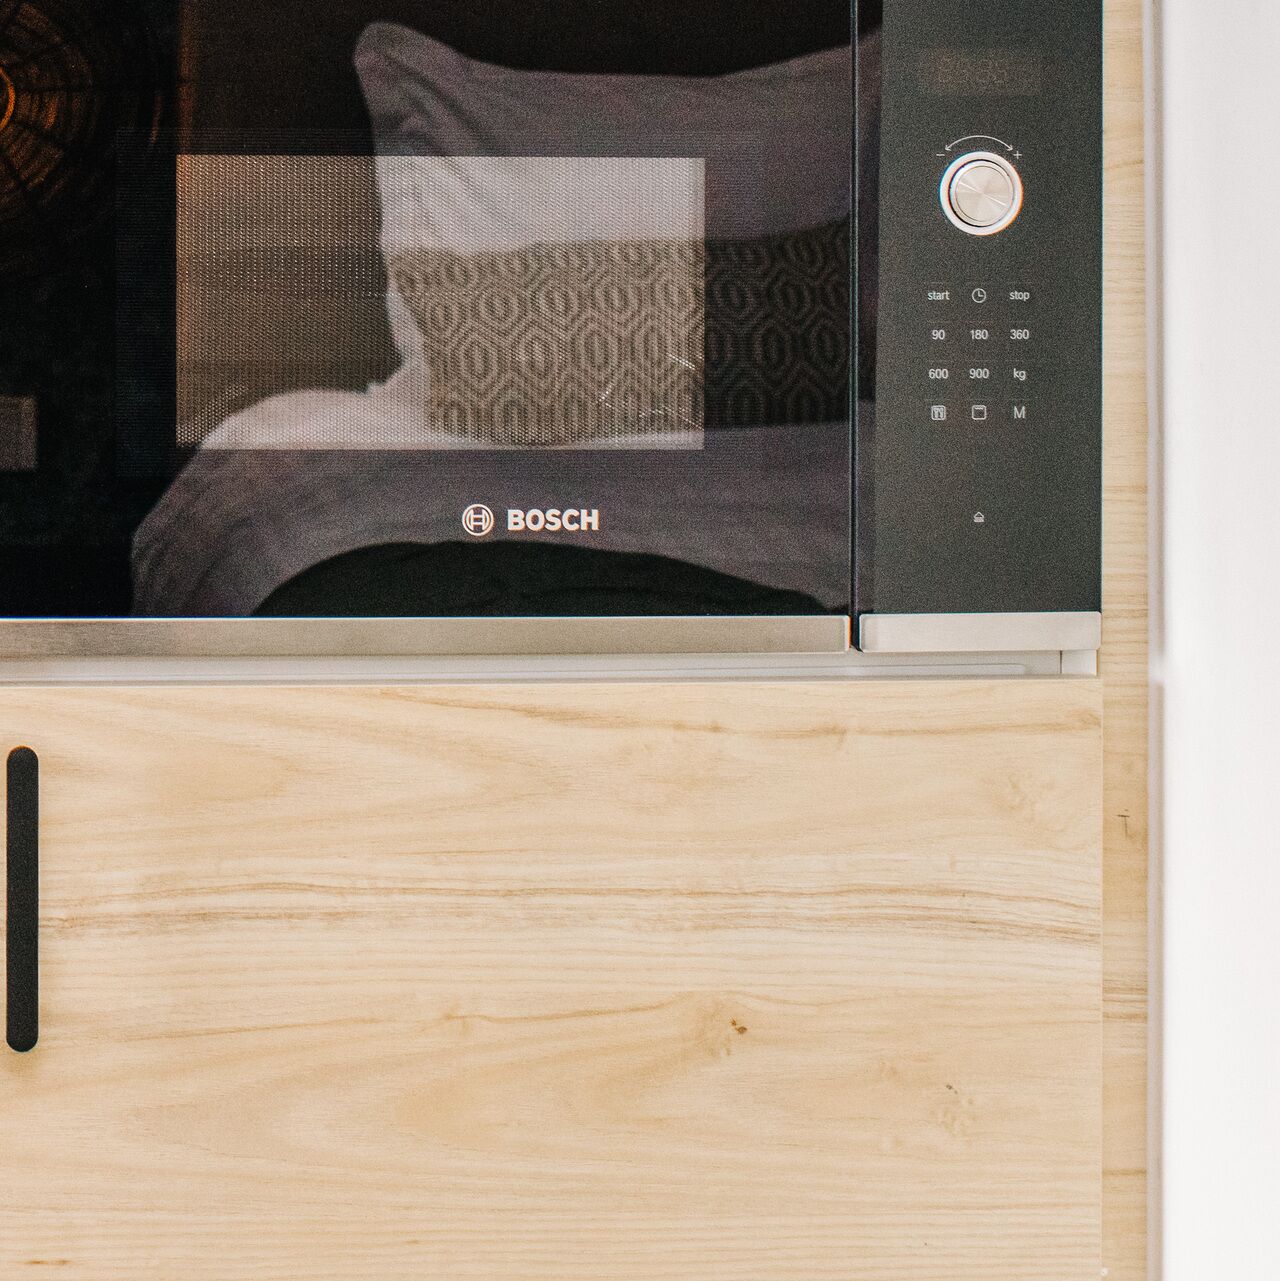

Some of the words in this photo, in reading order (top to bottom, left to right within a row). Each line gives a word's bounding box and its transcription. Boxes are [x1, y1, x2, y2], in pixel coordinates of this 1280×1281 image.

[927, 290, 950, 300] start
[1009, 290, 1030, 301] stop
[931, 329, 945, 340] 90
[970, 329, 988, 340] 180
[1009, 328, 1029, 340] 360
[928, 368, 949, 379] 600
[969, 368, 989, 379] 900
[1013, 368, 1026, 381] kg
[1013, 405, 1026, 419] M
[507, 508, 599, 531] BOSCH
